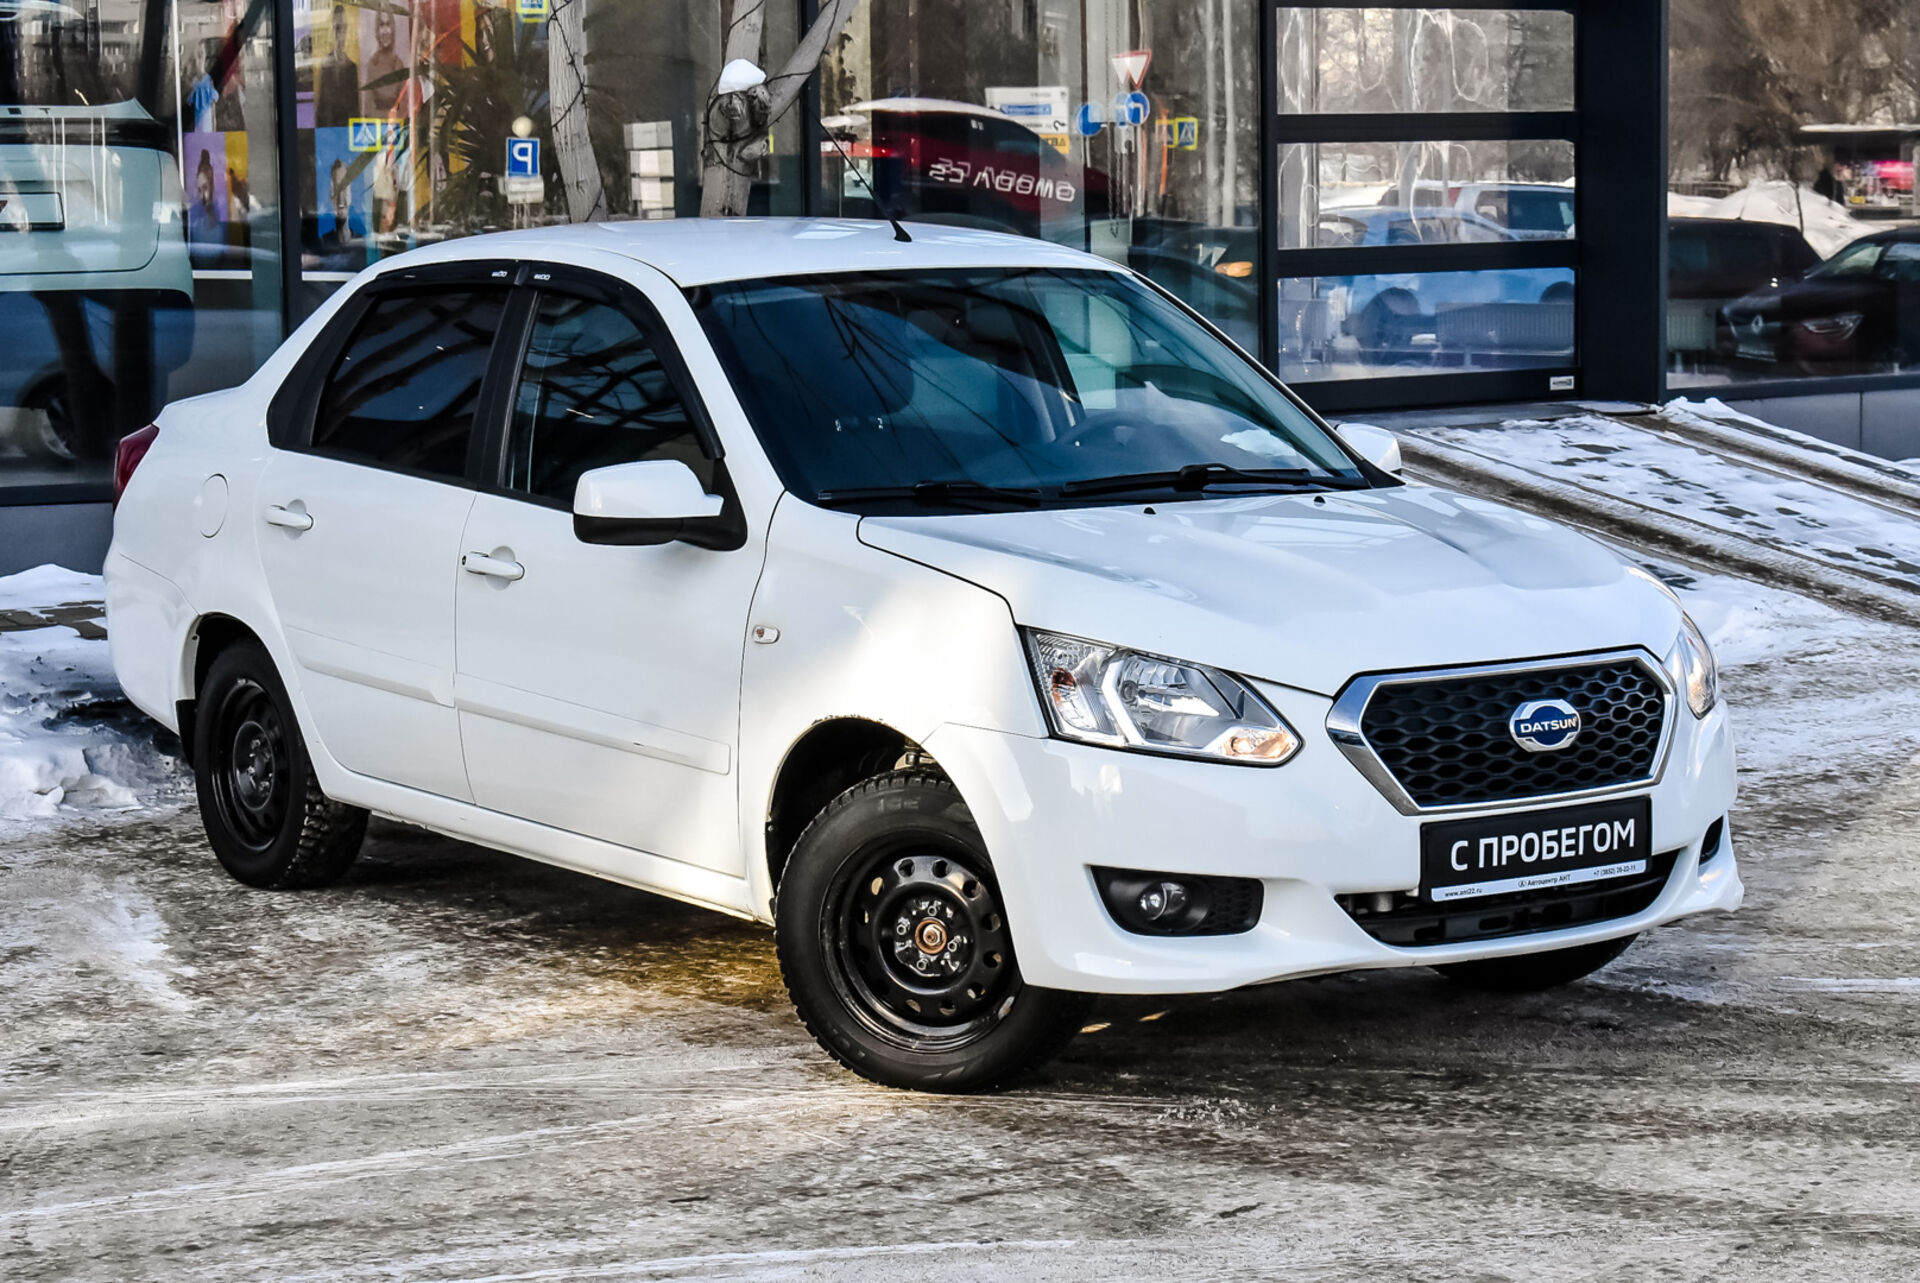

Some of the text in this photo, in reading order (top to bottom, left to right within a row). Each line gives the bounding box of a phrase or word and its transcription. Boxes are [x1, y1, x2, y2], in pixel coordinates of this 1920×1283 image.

[1520, 718, 1577, 734] DATSUN
[1451, 818, 1635, 871] С ПРОБЕГОМ
